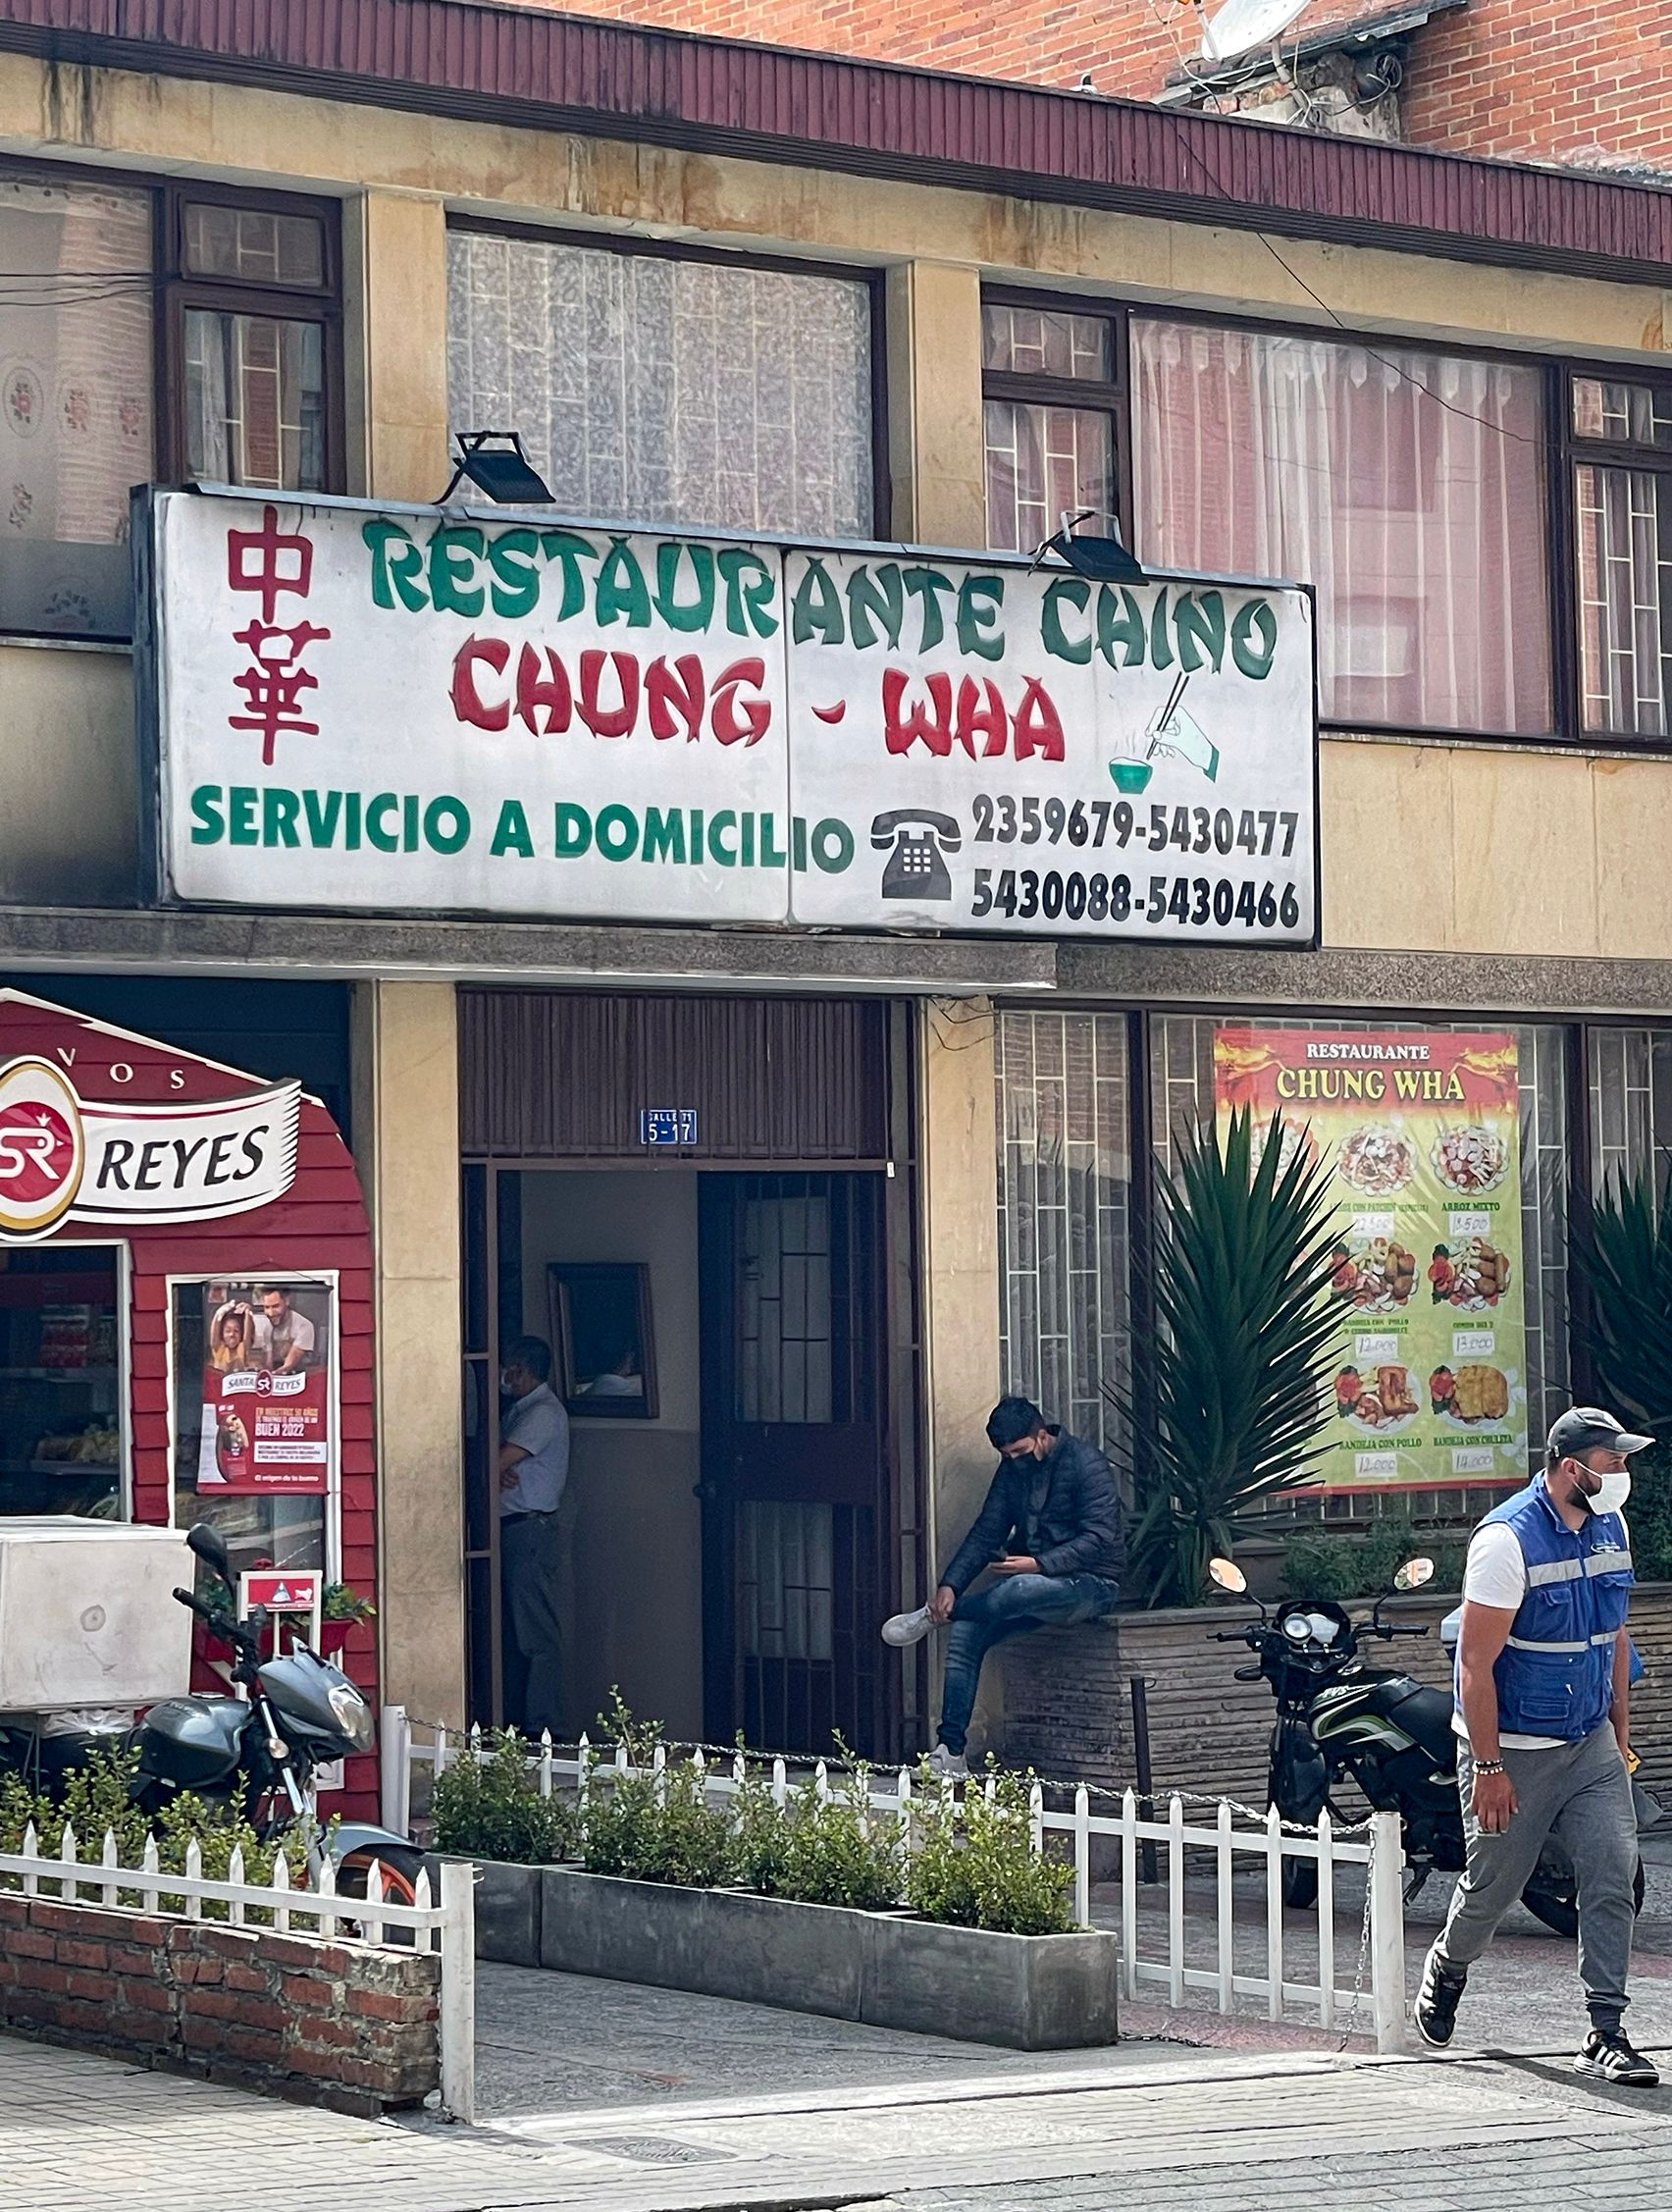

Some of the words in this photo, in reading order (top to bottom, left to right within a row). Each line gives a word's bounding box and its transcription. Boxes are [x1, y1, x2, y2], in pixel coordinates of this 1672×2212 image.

[360, 517, 1006, 662] RESTAURANTE
[1040, 577, 1278, 681] CHINO
[227, 503, 332, 766] 中華
[447, 632, 773, 749] CHUNG
[882, 666, 1066, 764] WHA
[189, 783, 472, 856] SERVICIO
[490, 799, 536, 859] A
[553, 801, 856, 875] DOMICILIO
[971, 793, 1300, 860] 2359679-5430477
[970, 868, 1300, 929] 5430088-5430466
[1306, 1042, 1431, 1061] RESTAURANTE
[1276, 1067, 1386, 1100] CHUNG
[1393, 1068, 1467, 1101] WHA
[649, 1123, 691, 1141] 5-17
[96, 1125, 270, 1190] REYES
[1441, 1202, 1471, 1212] ARROZ
[275, 1378, 301, 1391] REYES
[255, 1423, 281, 1437] BUEN
[281, 1423, 305, 1437] 2022
[1379, 1439, 1395, 1448] CON
[1396, 1437, 1423, 1448] POLLO
